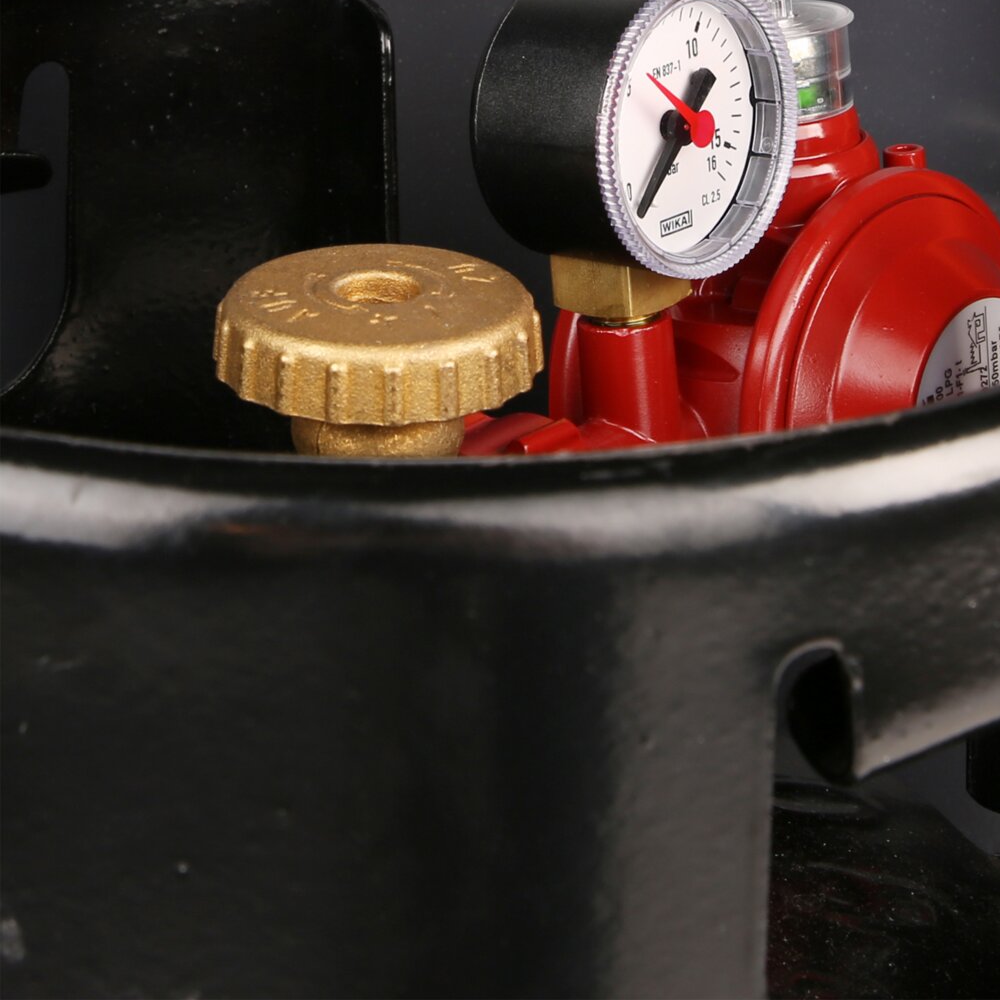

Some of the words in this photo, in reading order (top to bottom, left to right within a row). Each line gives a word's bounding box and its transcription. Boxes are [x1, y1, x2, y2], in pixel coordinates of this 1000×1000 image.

[686, 37, 698, 59] 10
[706, 155, 717, 172] 16
[662, 215, 691, 233] WIKA
[944, 368, 954, 397] LPG
